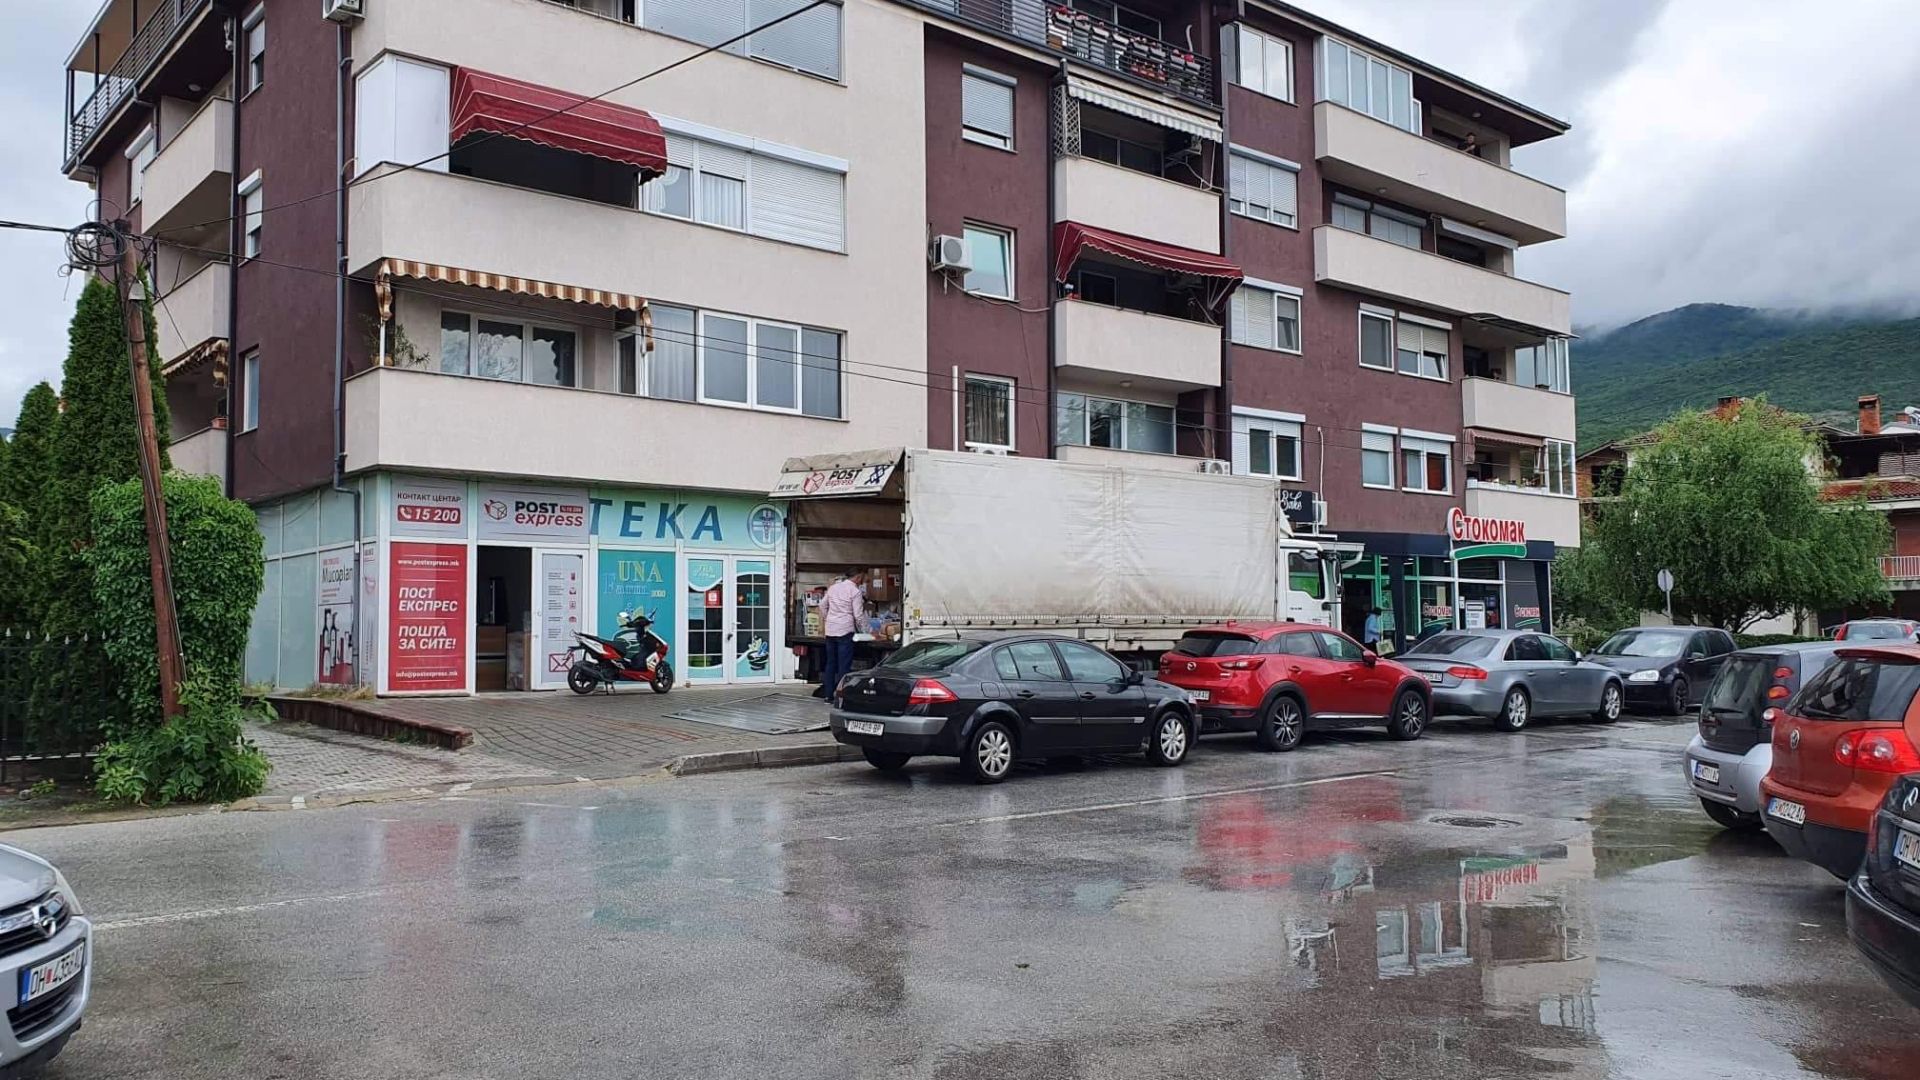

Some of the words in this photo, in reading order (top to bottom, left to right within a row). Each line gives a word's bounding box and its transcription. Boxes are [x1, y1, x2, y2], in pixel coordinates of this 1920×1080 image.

[829, 469, 862, 480] POST
[398, 493, 430, 501] КОНТАКТ
[432, 495, 461, 503] ЦЕНТАР
[515, 501, 558, 514] POST
[415, 508, 430, 521] 15
[433, 508, 459, 522] 200
[515, 512, 583, 527] express
[1452, 508, 1525, 543] Стокомак
[618, 560, 665, 582] UNA
[399, 587, 435, 598] ПОСТ
[399, 600, 458, 611] ЕКСПРЕС
[399, 625, 447, 637] ПОШТА
[398, 638, 416, 649] ЗА
[420, 638, 456, 649] СИТЕ!
